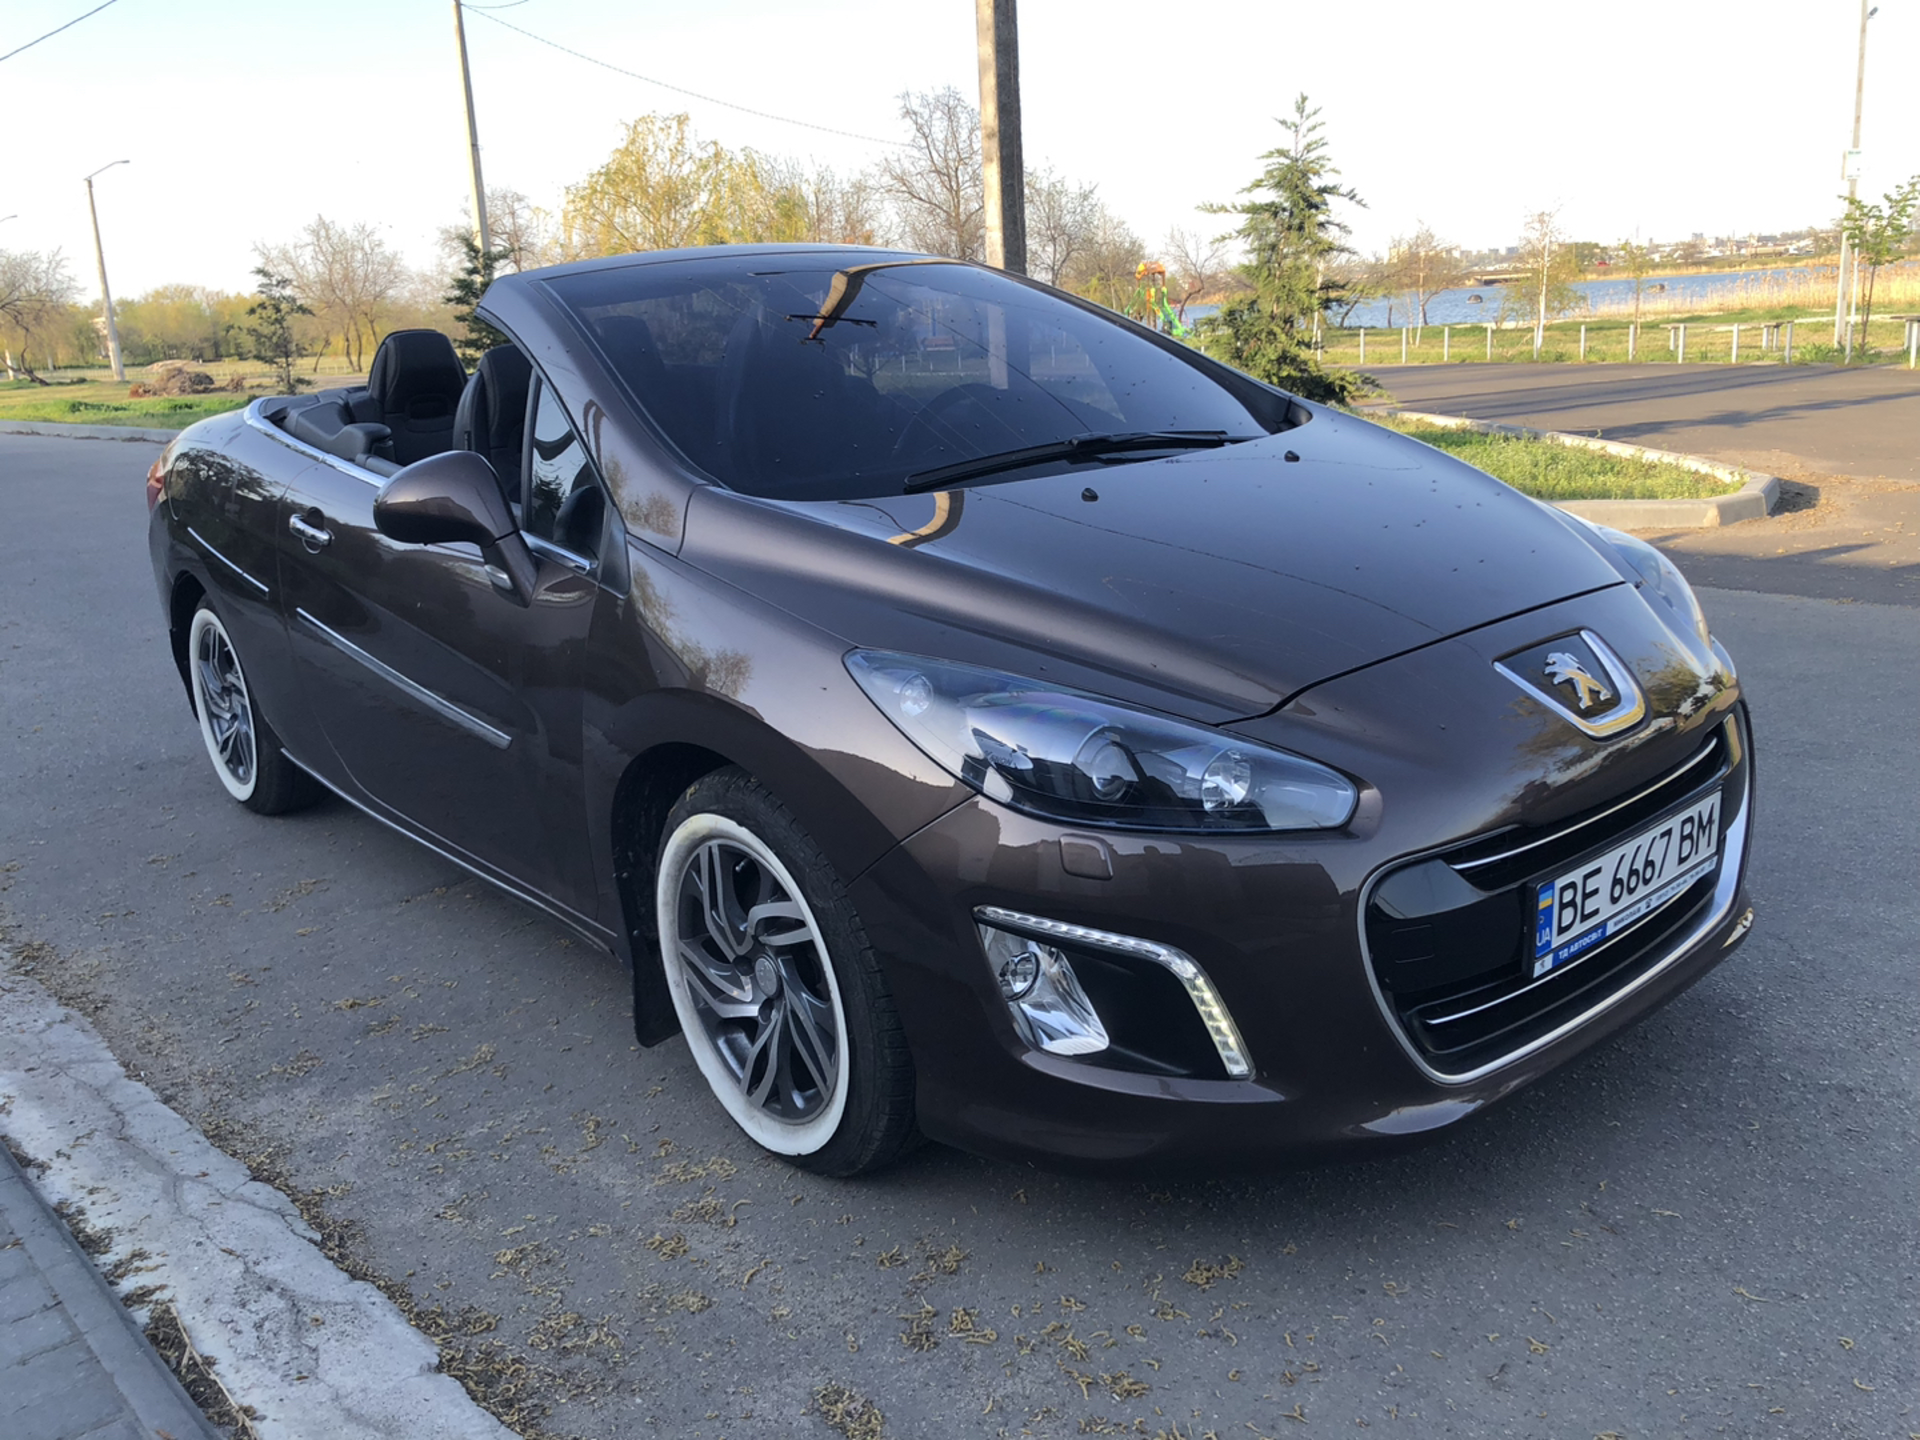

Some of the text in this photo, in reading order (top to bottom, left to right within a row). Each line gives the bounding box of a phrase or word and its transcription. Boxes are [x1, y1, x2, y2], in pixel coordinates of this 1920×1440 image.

[1557, 865, 1602, 937] BE
[1610, 828, 1673, 905] 6667
[1677, 801, 1715, 867] BM
[1536, 927, 1551, 947] UA
